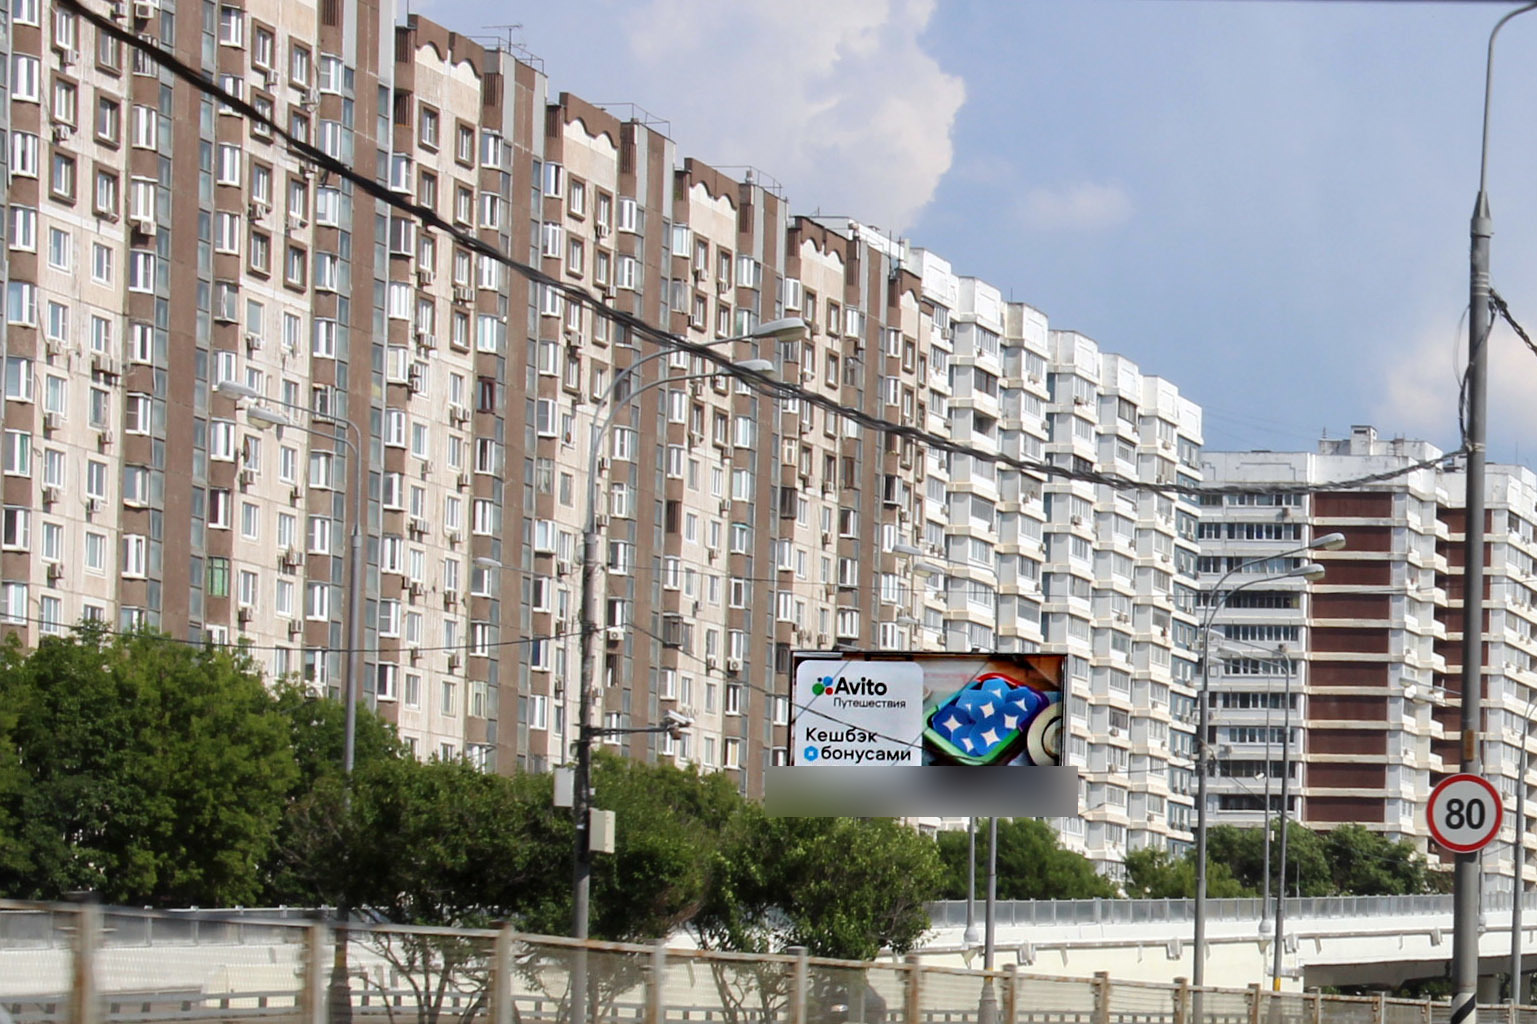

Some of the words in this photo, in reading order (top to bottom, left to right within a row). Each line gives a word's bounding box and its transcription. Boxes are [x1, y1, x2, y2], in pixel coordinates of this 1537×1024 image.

[834, 677, 887, 696] Avito
[833, 697, 906, 709] Путешествия
[805, 727, 877, 743] Кешбэк
[822, 745, 911, 763] бонусами
[1445, 798, 1485, 829] 80
